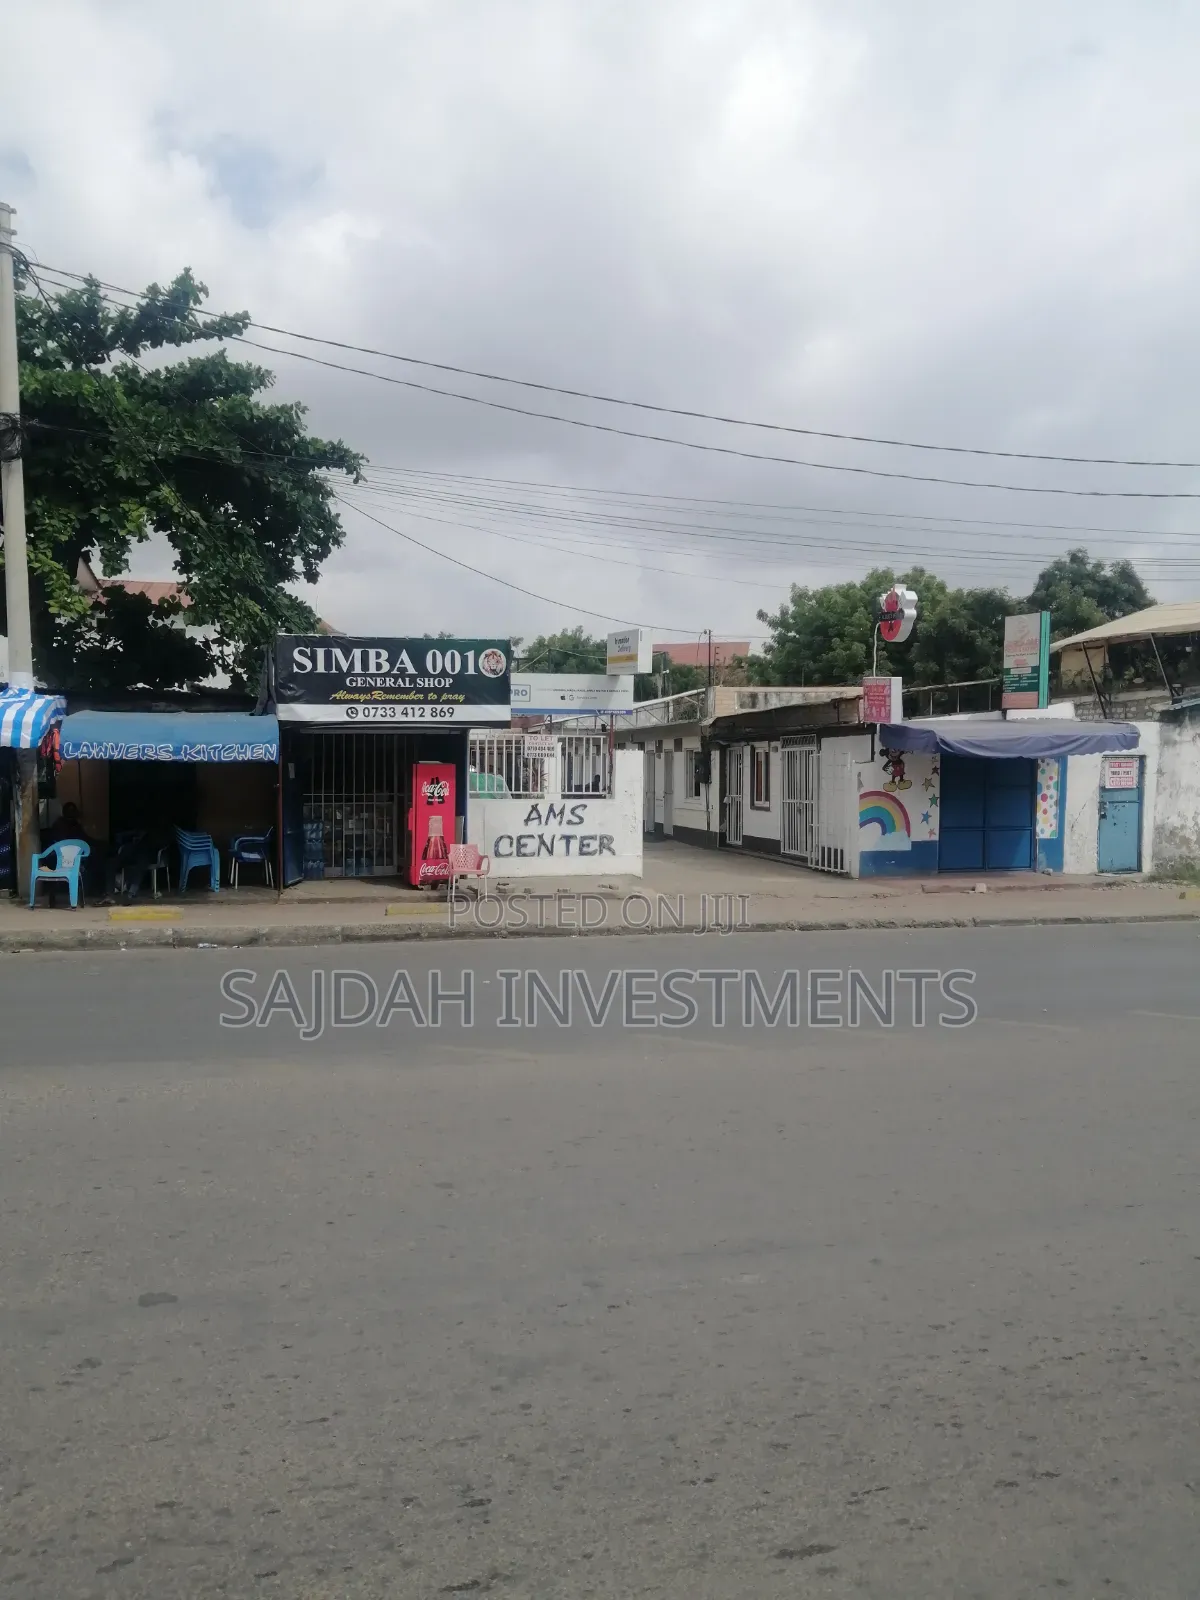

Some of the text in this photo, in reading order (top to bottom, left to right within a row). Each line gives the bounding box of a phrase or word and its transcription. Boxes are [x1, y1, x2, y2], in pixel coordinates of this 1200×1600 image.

[292, 646, 478, 675] SIMBA 001
[345, 676, 453, 688] GENERAL SHOP
[427, 692, 438, 700] to
[440, 692, 466, 702] pray
[362, 706, 455, 718] 0733 412 869
[63, 741, 277, 762] LAWYERS KITCHEN
[422, 781, 449, 797] Coca-Cola
[523, 802, 588, 826] AMS
[493, 832, 616, 857] CENTER
